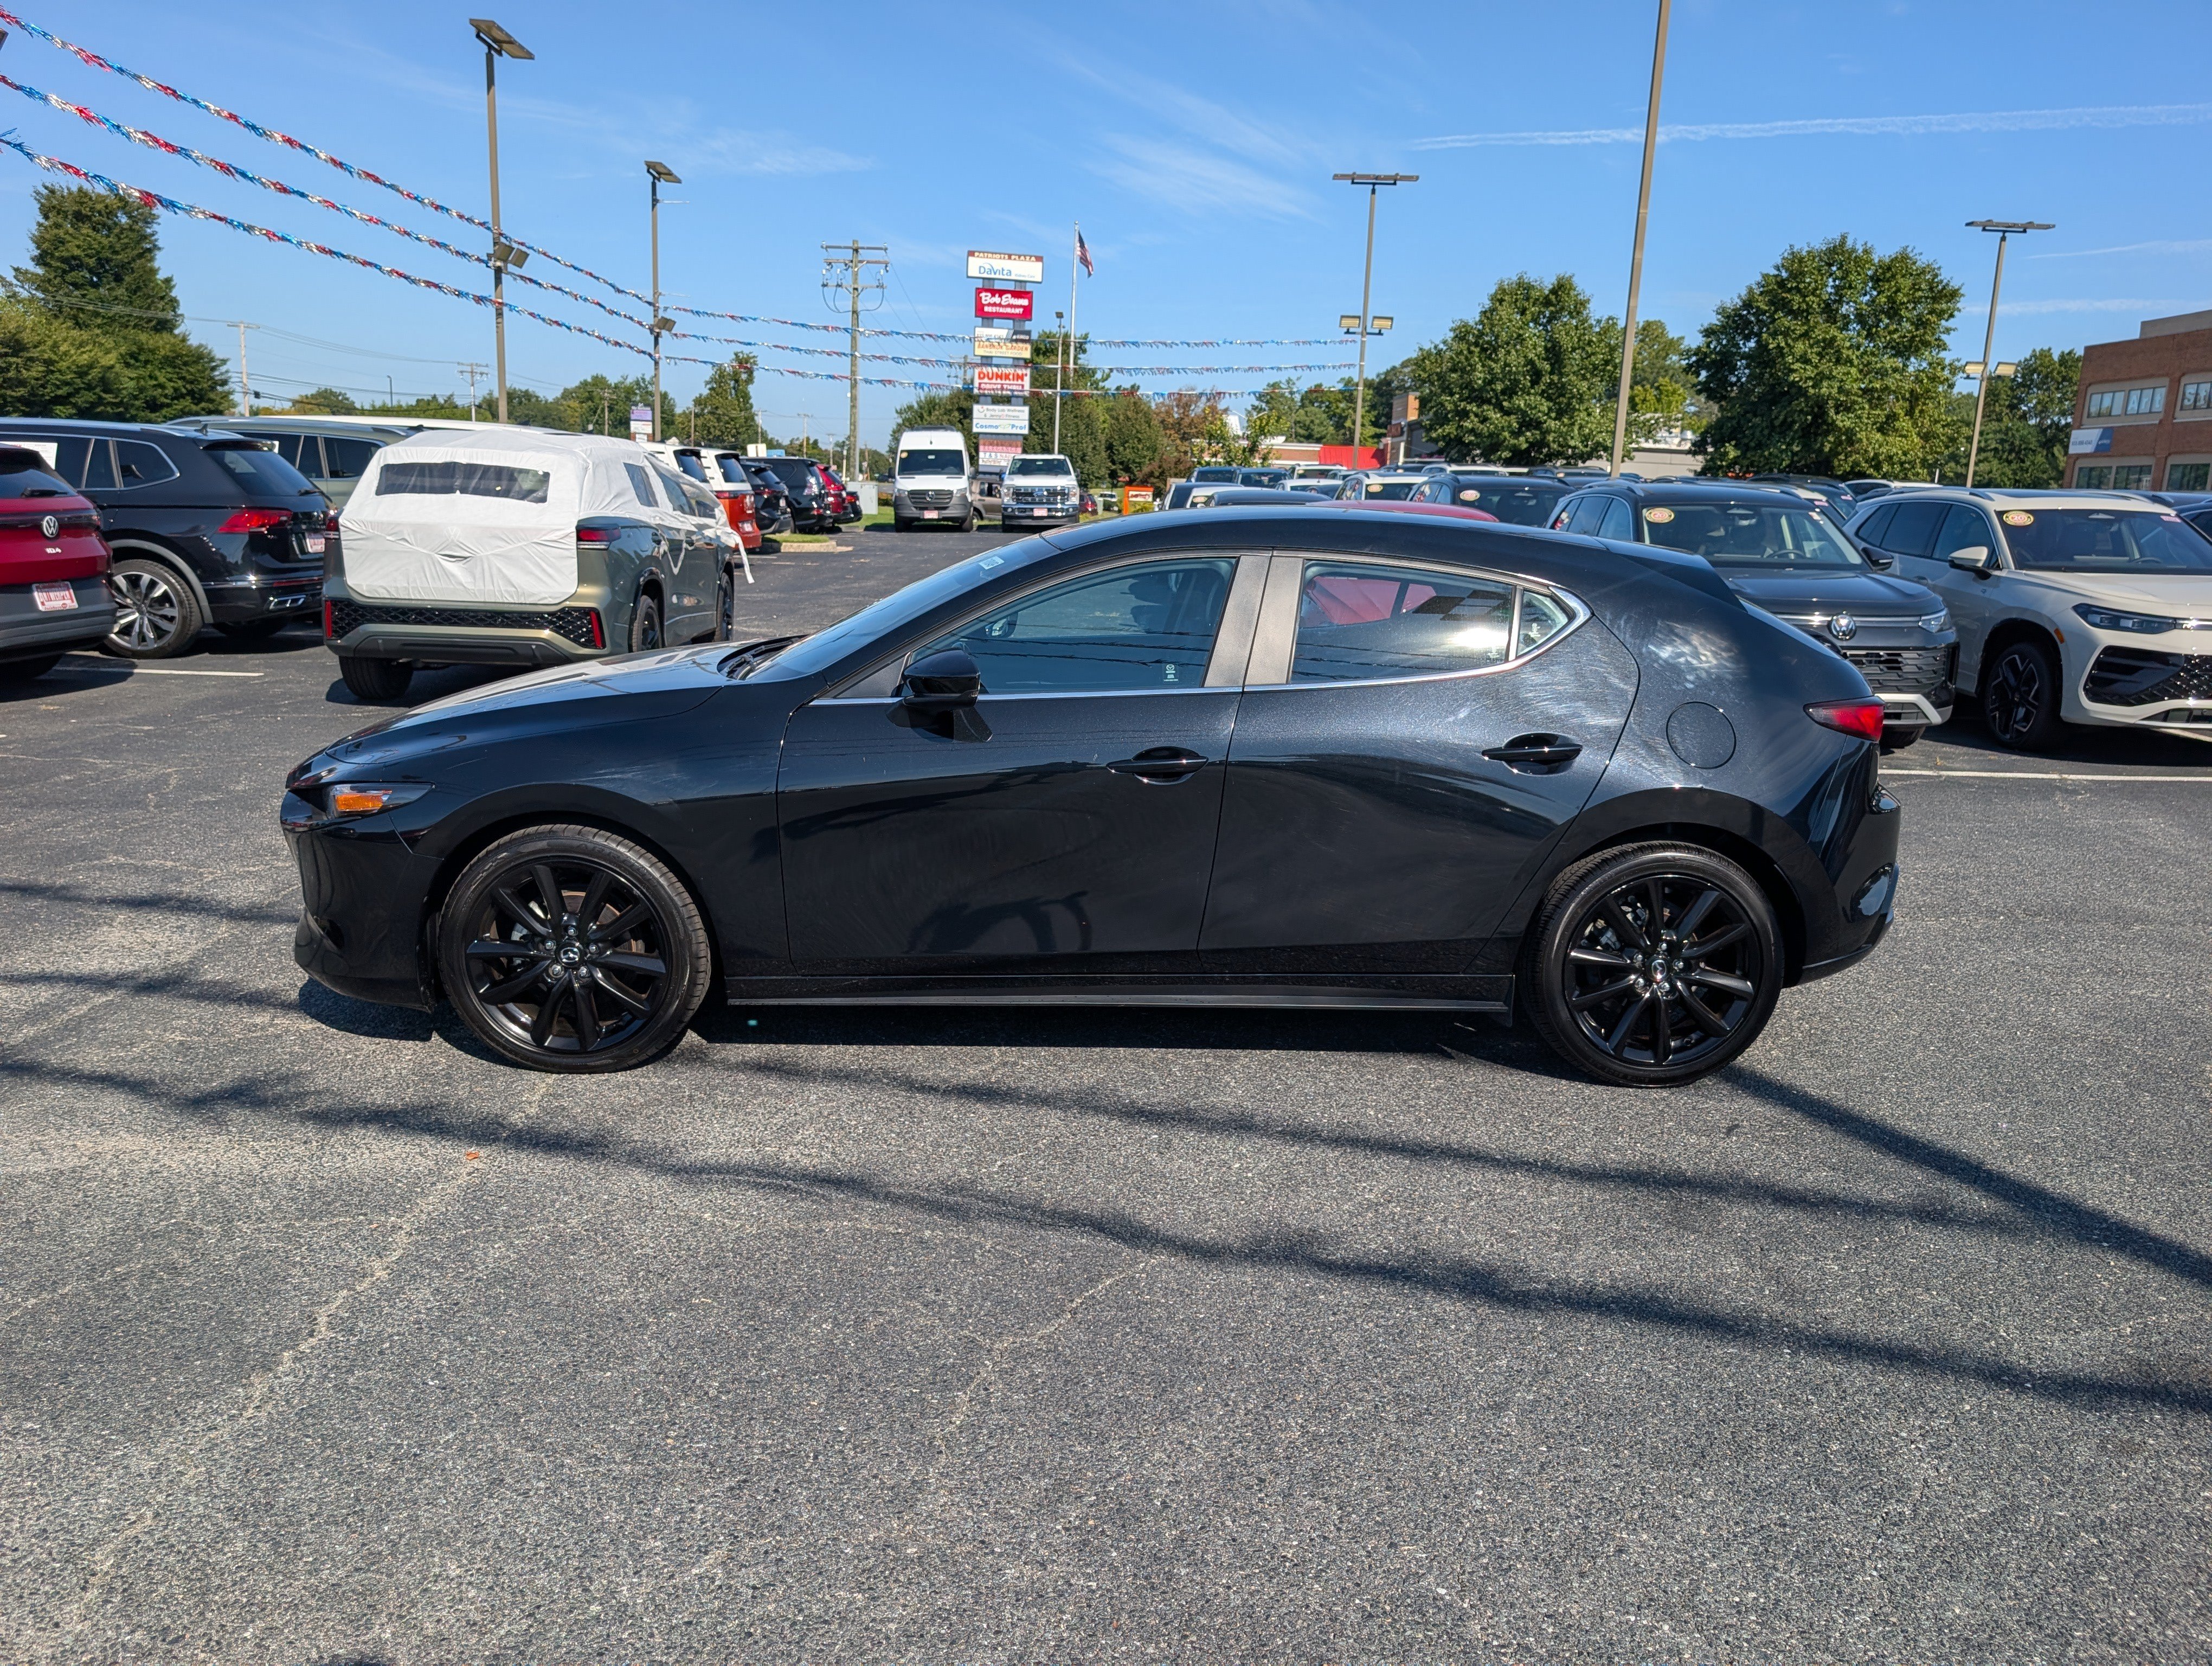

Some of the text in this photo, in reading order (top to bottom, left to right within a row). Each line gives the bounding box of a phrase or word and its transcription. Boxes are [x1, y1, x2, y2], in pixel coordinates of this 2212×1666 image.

[974, 252, 1008, 260] PATRIOTS
[978, 262, 1012, 277] DaVita
[979, 292, 1029, 306] Bob Evans
[983, 306, 1024, 314] RESTAURANT
[2128, 393, 2163, 410] Art
